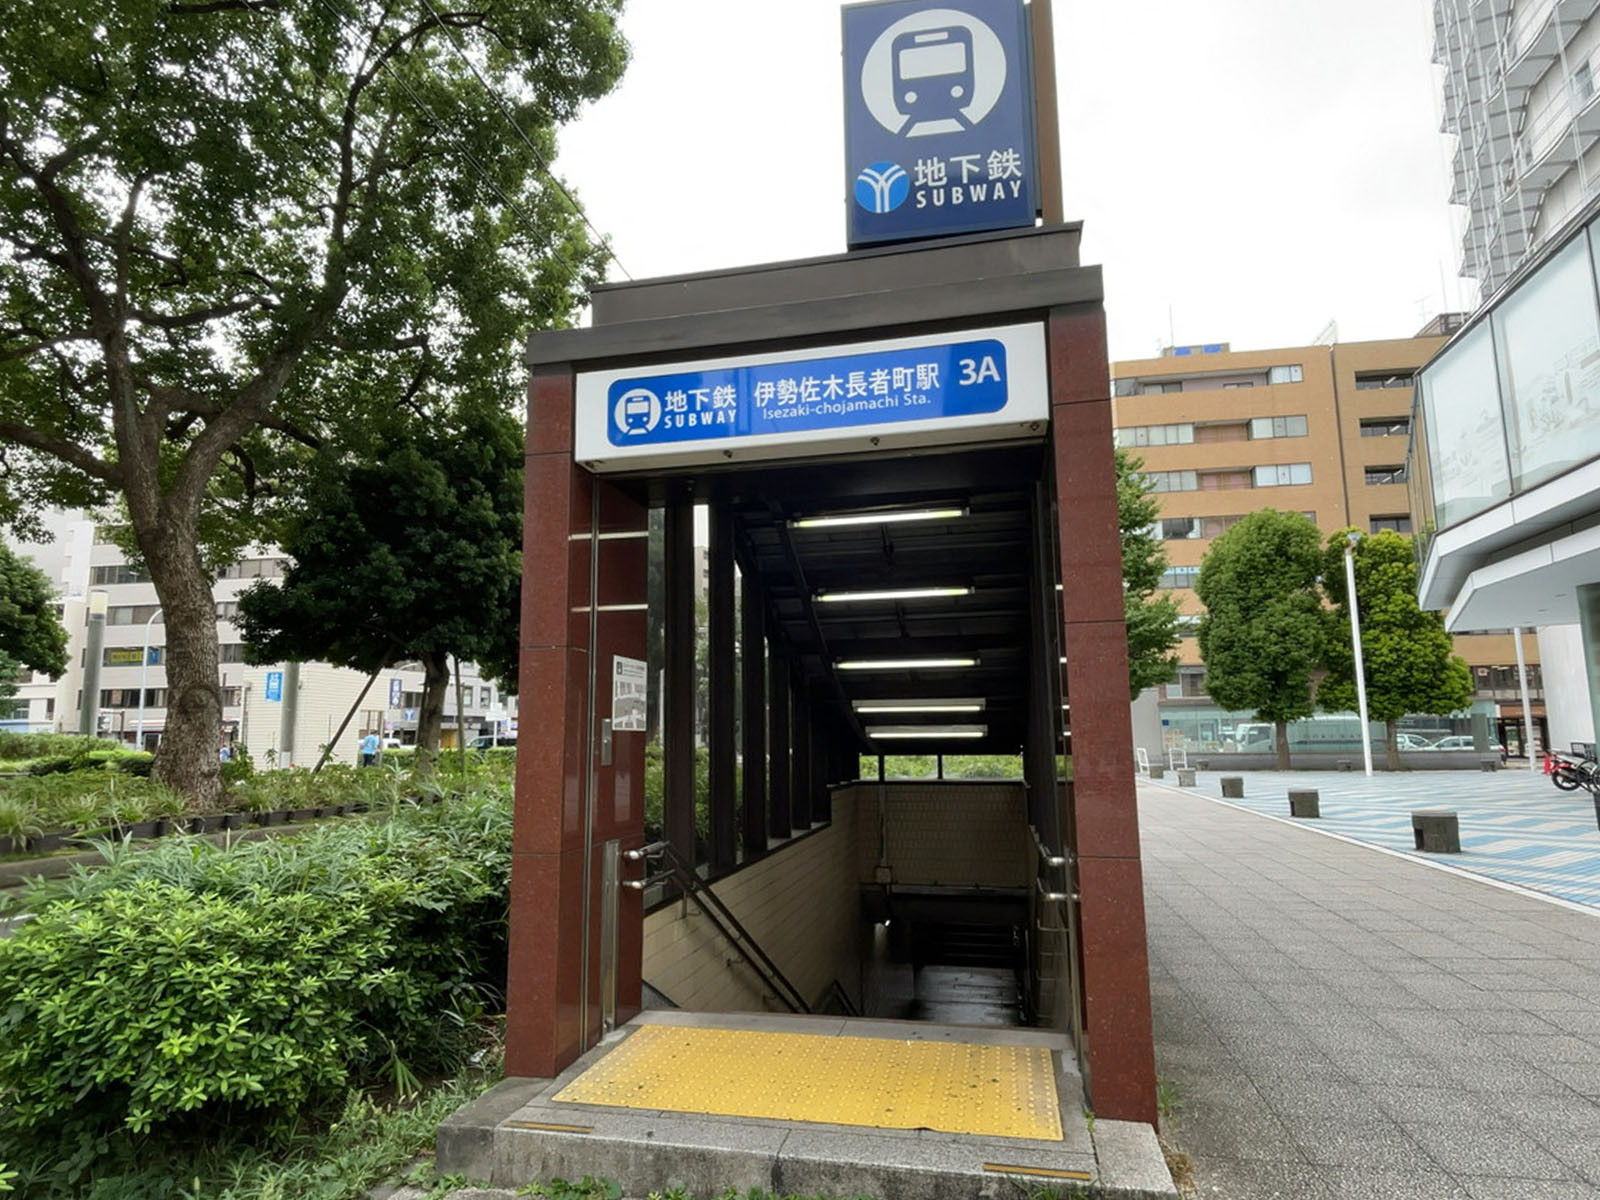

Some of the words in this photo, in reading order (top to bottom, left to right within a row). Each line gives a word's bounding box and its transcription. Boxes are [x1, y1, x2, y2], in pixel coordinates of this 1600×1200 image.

[914, 148, 1022, 187] 地下鉄
[916, 180, 1021, 208] SUBWAY
[754, 363, 940, 408] 伊勢佐木長者町駅
[959, 356, 1001, 386] 3A
[664, 384, 737, 413] 地下鉄
[763, 395, 899, 420] Isezaki-chojamachi
[904, 393, 932, 407] Sta.
[664, 409, 737, 429] SUBWAY
